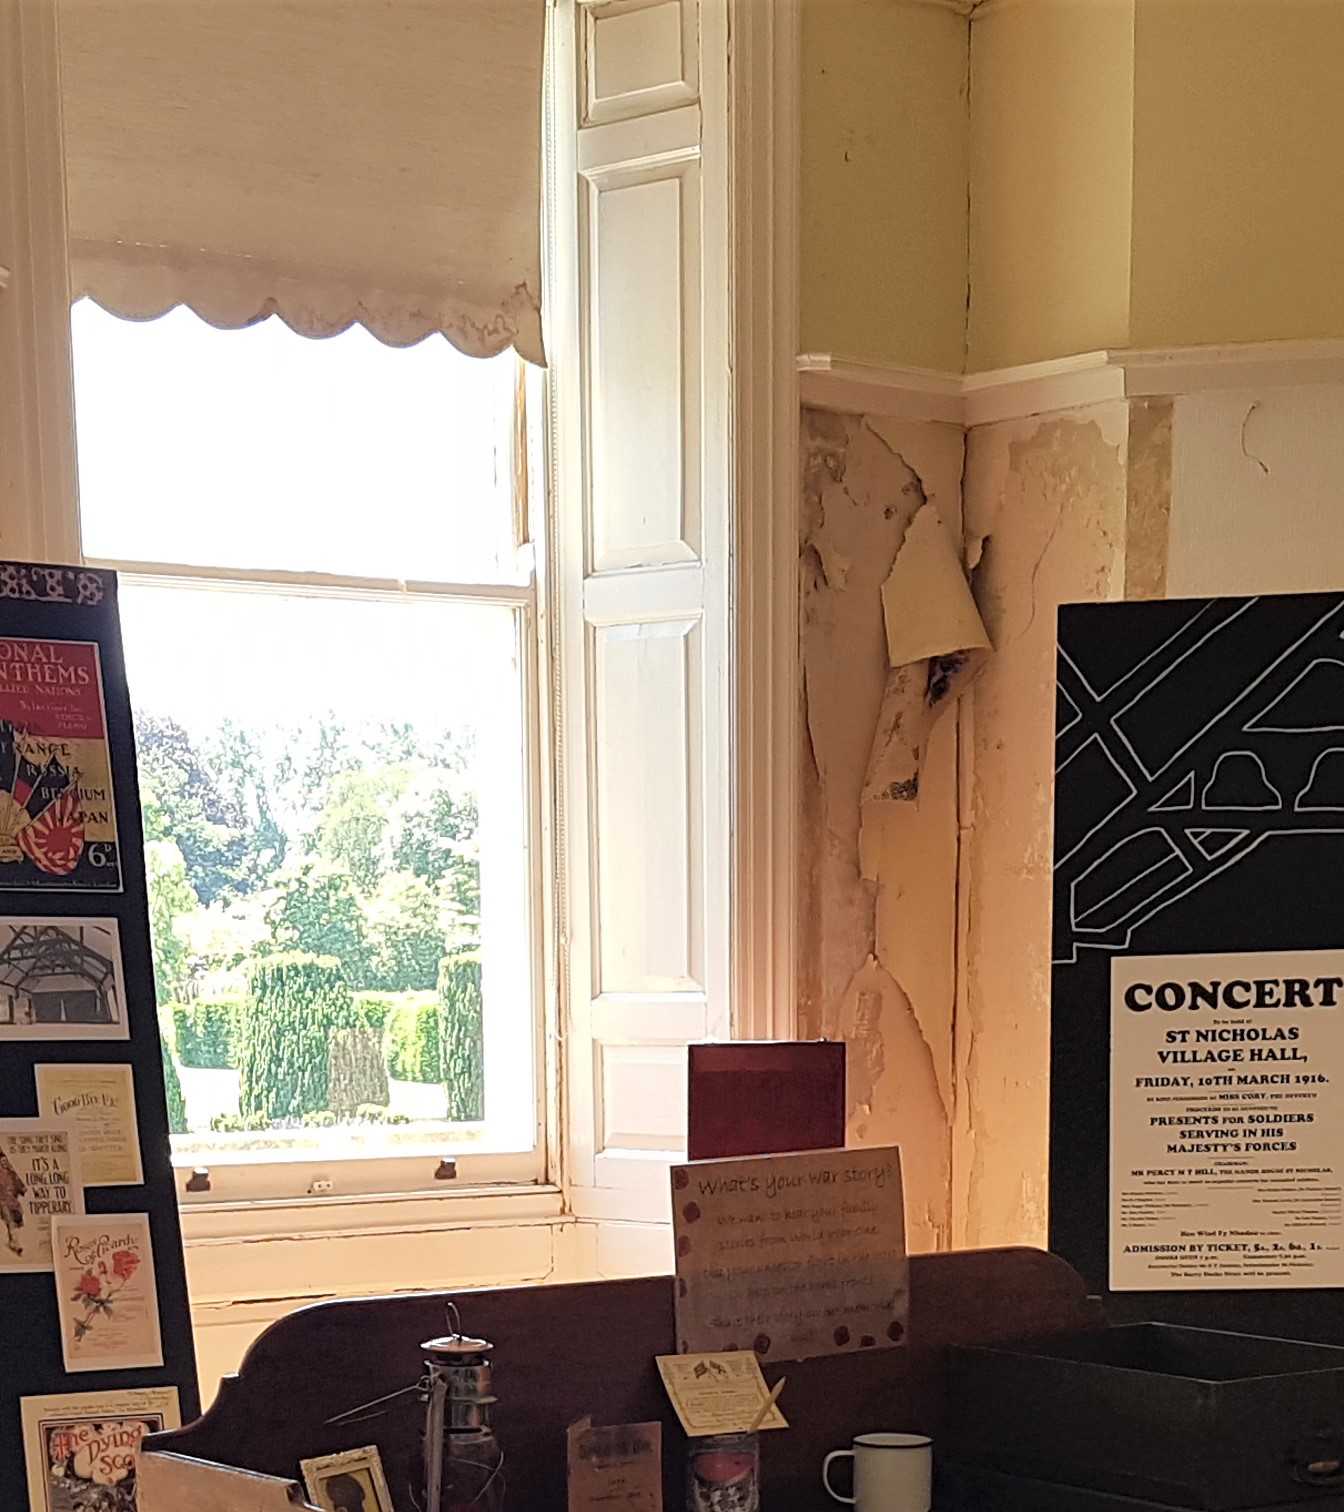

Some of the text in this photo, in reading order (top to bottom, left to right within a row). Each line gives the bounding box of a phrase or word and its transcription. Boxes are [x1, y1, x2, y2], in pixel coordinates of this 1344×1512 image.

[1124, 977, 1344, 1012] CONCERT
[1165, 1027, 1300, 1044] ST NICHOLAS
[1157, 1047, 1308, 1064] VILLAGE HALL,
[1135, 1073, 1329, 1088] FRIDAY, 10TH MARCH 1916.
[1149, 1115, 1219, 1127] PRESENTS
[1248, 1113, 1315, 1124] SOLDIERS
[1179, 1127, 1284, 1140] SERVING IN HIS
[1167, 1141, 1297, 1154] MAJESTY'S FORCES
[31, 1157, 60, 1172] IT'S A
[26, 1171, 70, 1186] LONG LONG
[699, 1163, 893, 1199] What's your war story?
[32, 1186, 67, 1200] WAY TO
[29, 1200, 73, 1215] TIPPERARY
[1123, 1244, 1186, 1253] ADMISSION
[1189, 1244, 1204, 1252] BY
[1206, 1243, 1251, 1253] TICKET,
[87, 1424, 142, 1466] Dying
